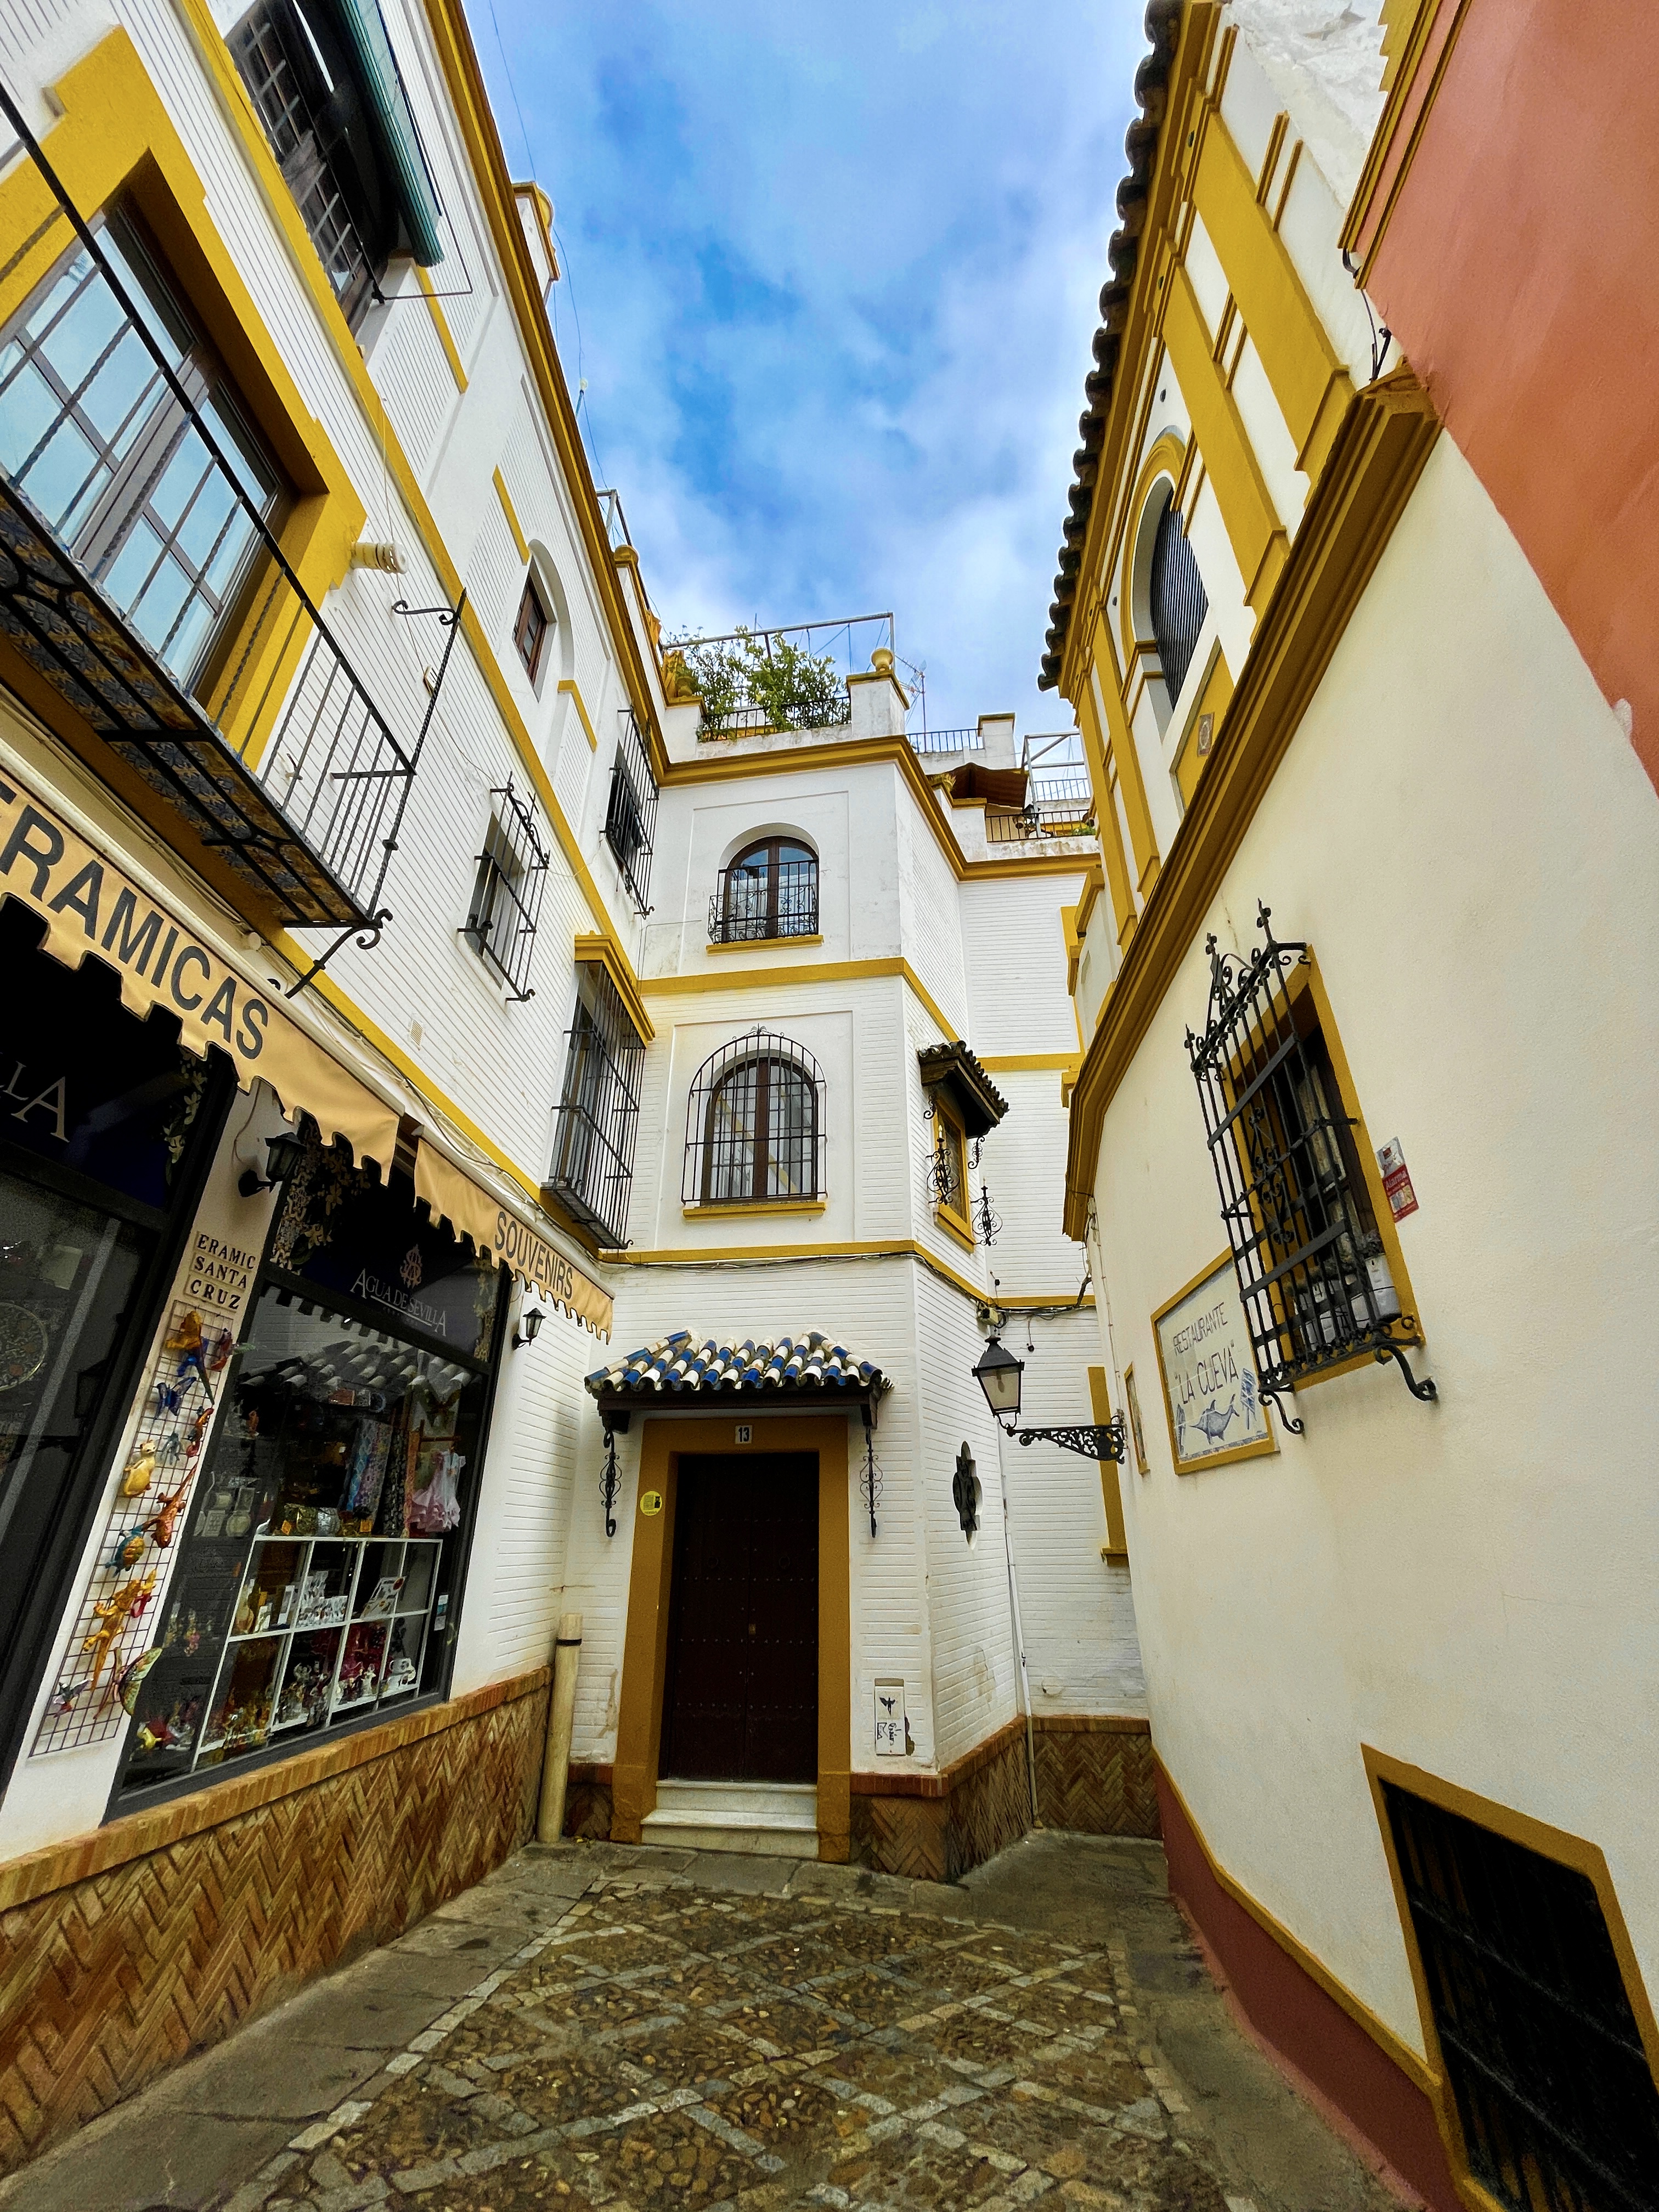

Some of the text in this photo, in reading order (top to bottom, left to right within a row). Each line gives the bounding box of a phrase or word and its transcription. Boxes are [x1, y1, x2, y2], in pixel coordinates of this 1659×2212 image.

[197, 1233, 256, 1269] ERAMIC
[494, 1211, 573, 1300] SOUVENIRS
[194, 1256, 247, 1289] SANTA
[190, 1279, 241, 1310] CRUZ
[393, 1289, 409, 1310] DE
[407, 1296, 447, 1336] SEVILLA
[1173, 1302, 1228, 1356] RESTAURANTE
[738, 1427, 750, 1442] 13
